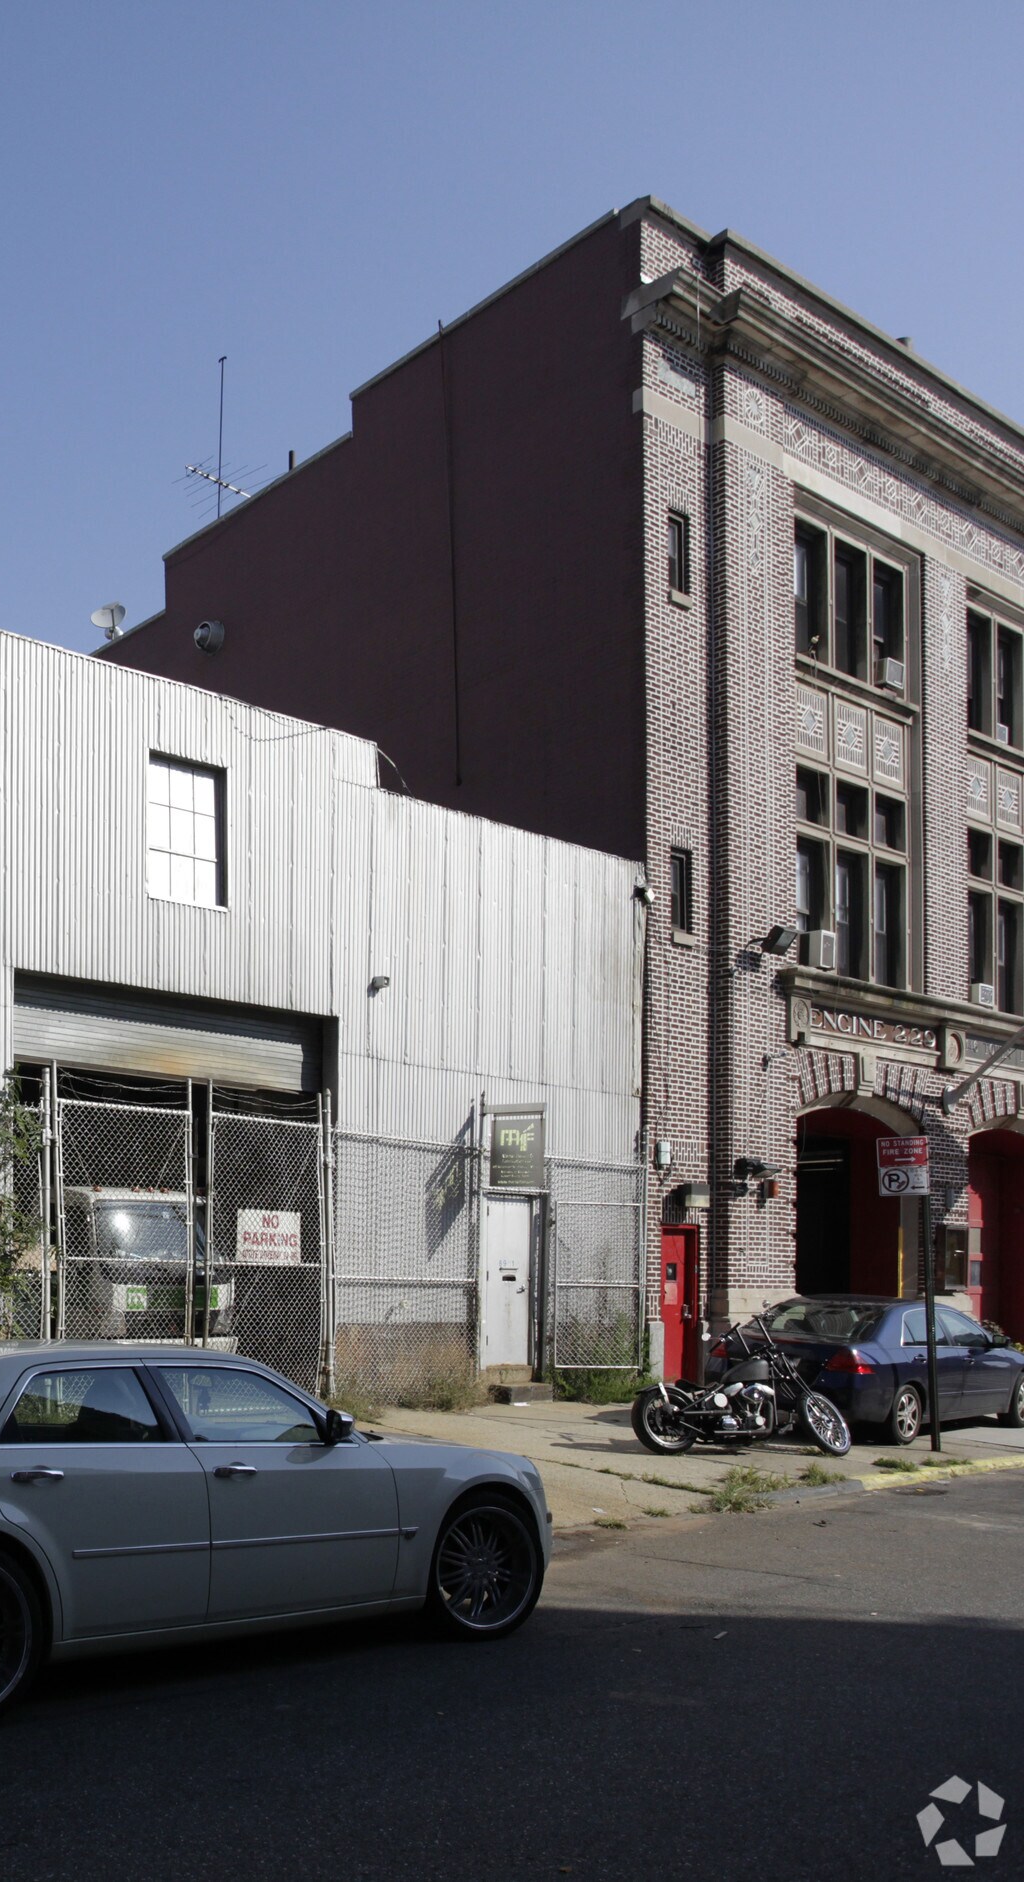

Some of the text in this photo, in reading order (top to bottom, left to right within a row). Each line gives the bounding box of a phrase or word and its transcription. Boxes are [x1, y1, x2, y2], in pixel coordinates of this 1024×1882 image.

[810, 1008, 887, 1039] ENGINE
[893, 1139, 924, 1147] STANDING
[882, 1147, 923, 1156] FIRE ZONE
[262, 1214, 280, 1229] NO
[242, 1230, 299, 1247] PARKING
